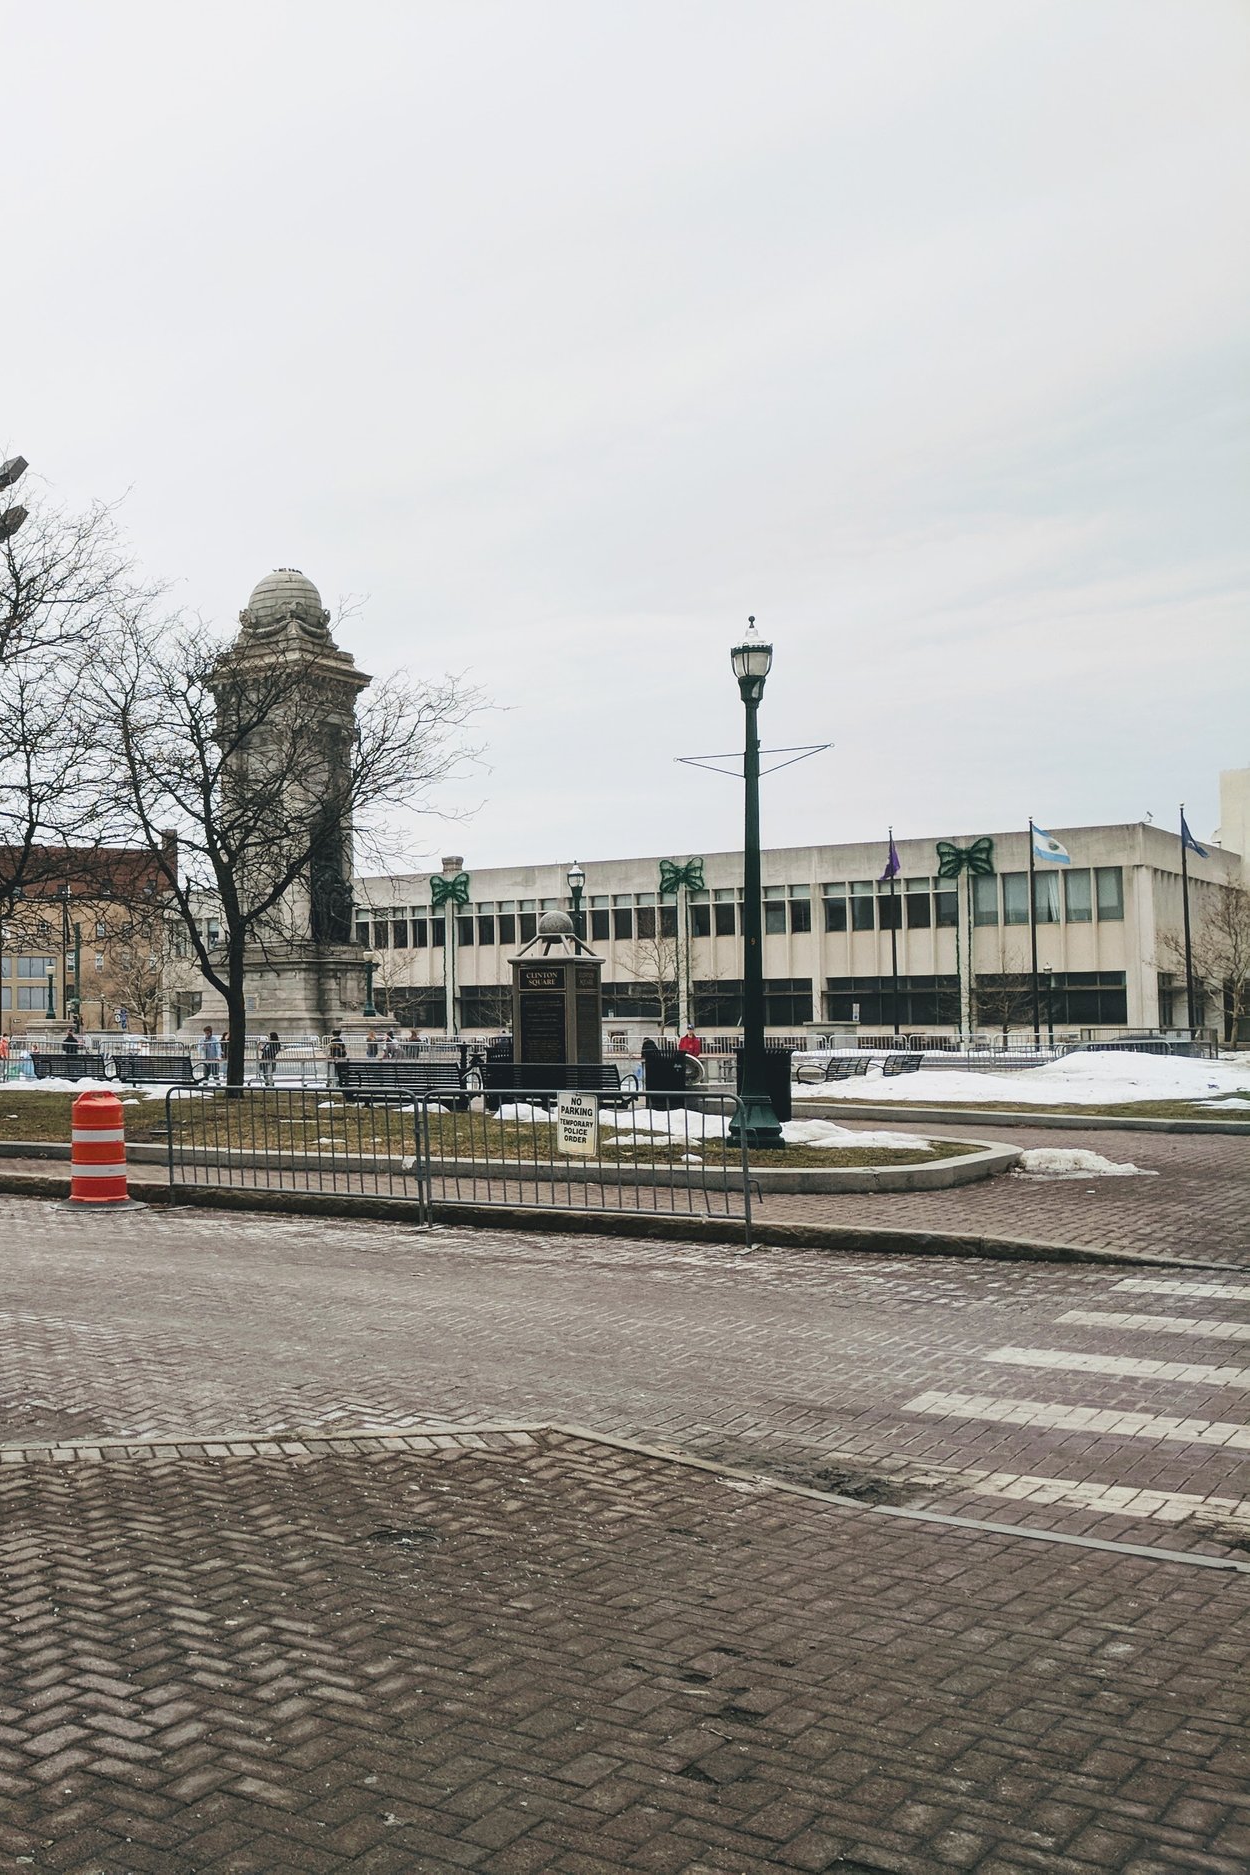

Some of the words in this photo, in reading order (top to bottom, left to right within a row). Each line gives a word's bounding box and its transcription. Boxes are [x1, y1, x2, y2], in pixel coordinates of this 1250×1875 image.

[571, 1097, 582, 1106] NO
[561, 1105, 593, 1117] PARKING
[560, 1118, 594, 1128] TEMPORARY
[564, 1127, 588, 1136] POLICE
[564, 1135, 587, 1144] ORDER
